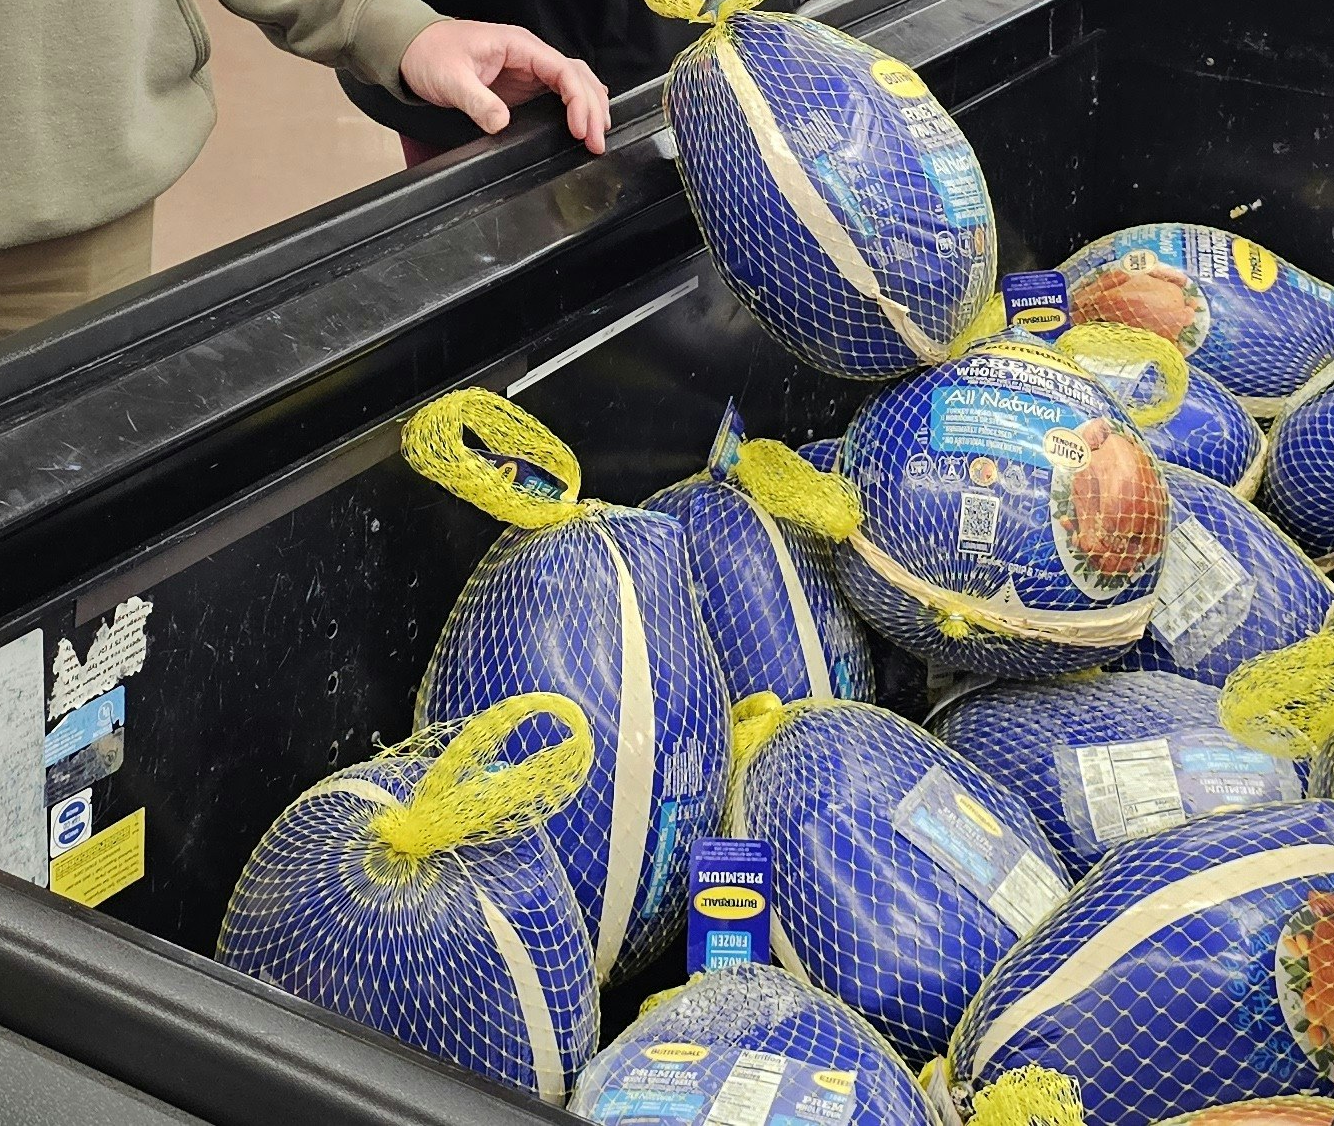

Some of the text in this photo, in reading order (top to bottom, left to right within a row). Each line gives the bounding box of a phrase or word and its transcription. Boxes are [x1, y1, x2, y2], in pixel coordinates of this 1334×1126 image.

[1010, 294, 1063, 308] PREMIUM
[969, 356, 1094, 398] PREMIUM
[956, 365, 1105, 411] WHOLE YOUNG TURKEY
[945, 389, 1062, 423] All Natural
[1052, 434, 1077, 449] TENDER
[1050, 443, 1085, 463] JUICY
[698, 870, 764, 885] PREMIUM
[701, 897, 758, 909] BUTTERBALL
[711, 934, 748, 948] FROZEN
[650, 1047, 704, 1058] BUTTERBALL
[741, 1050, 782, 1065] Nutrition
[629, 1067, 699, 1081] PREMIUM
